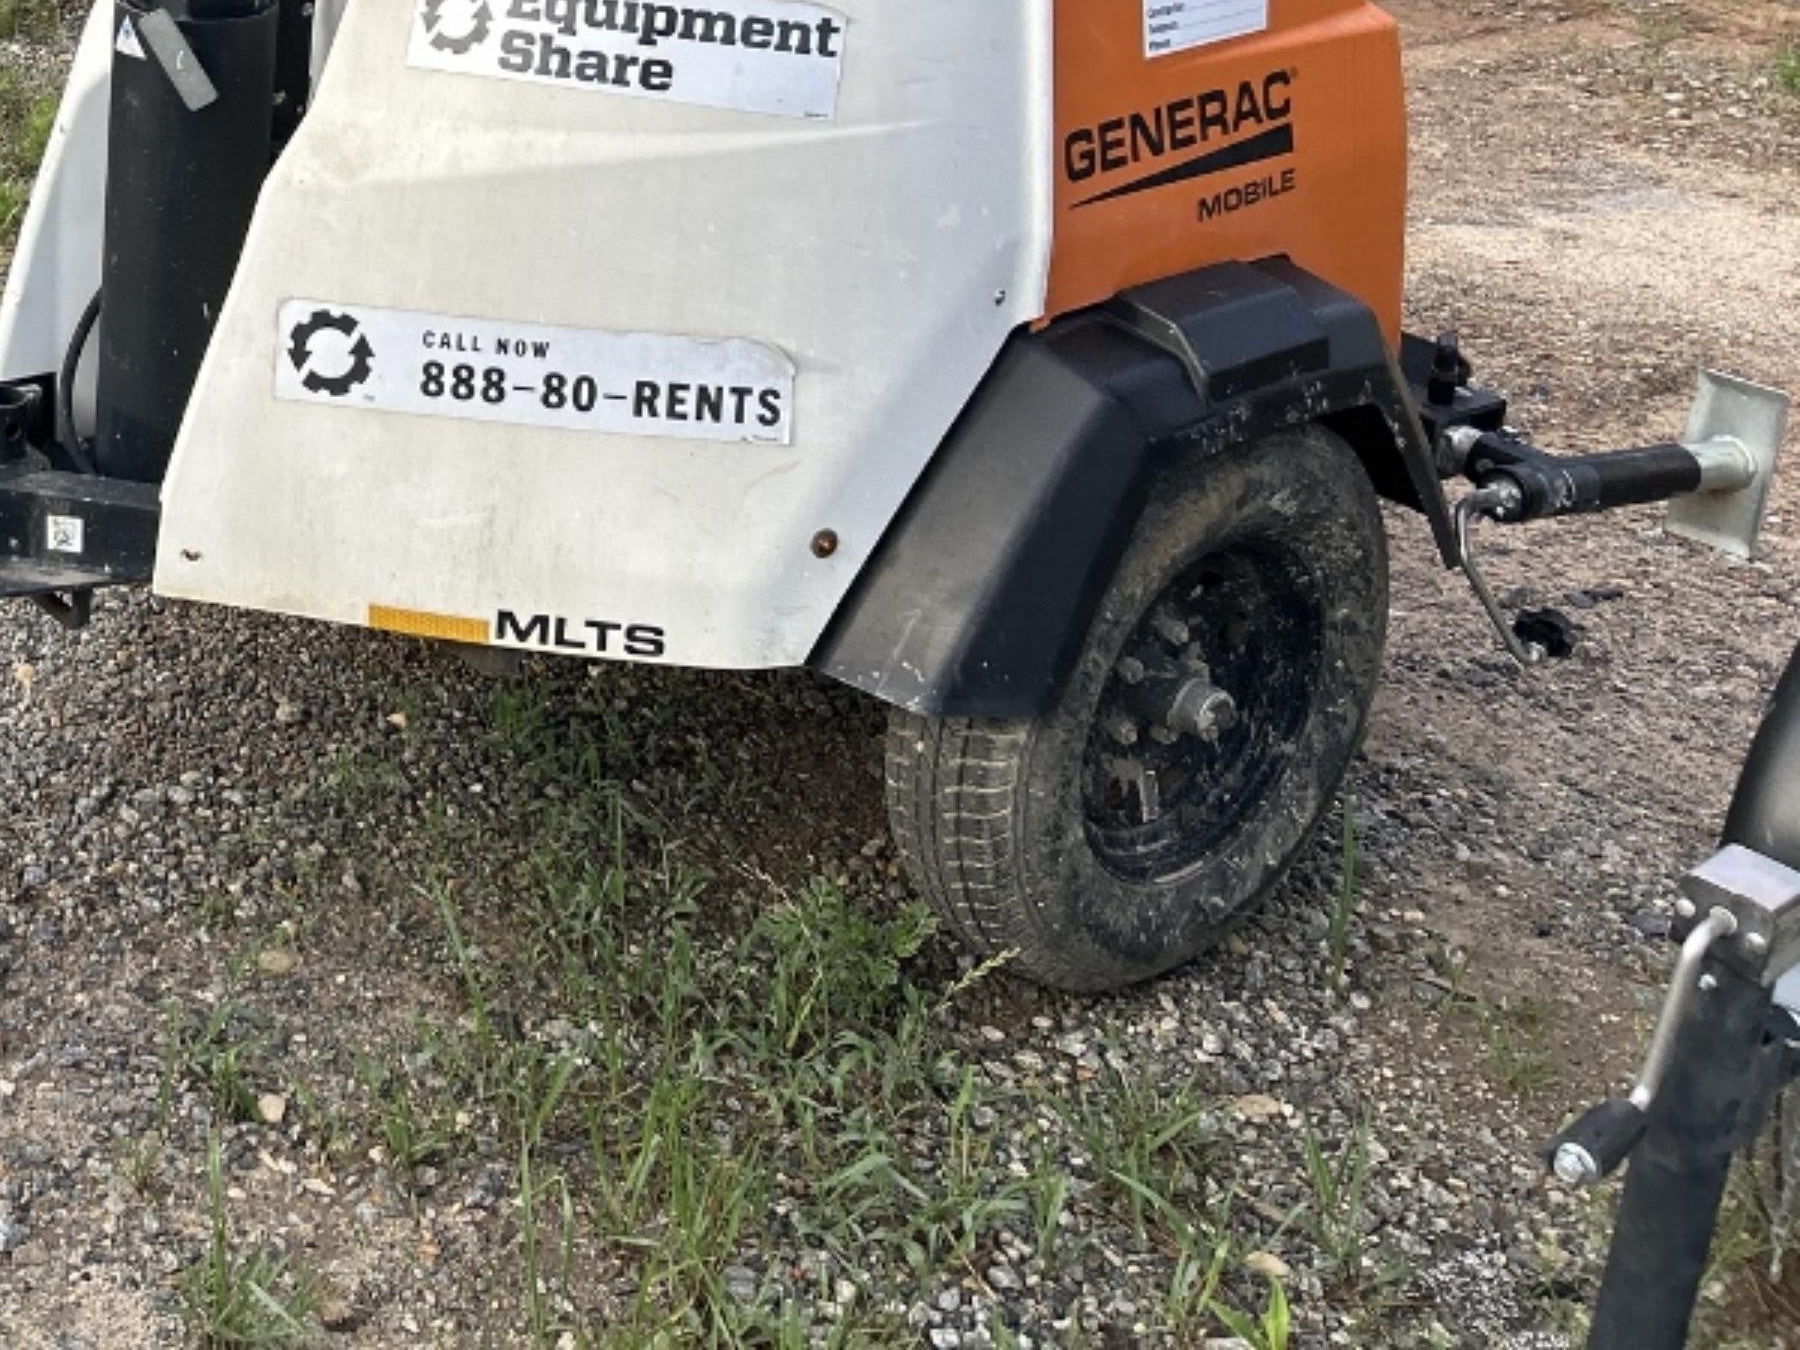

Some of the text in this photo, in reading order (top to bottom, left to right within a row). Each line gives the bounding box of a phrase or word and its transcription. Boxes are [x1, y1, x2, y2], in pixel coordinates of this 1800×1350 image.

[497, 29, 673, 91] Share
[1064, 68, 1293, 183] GENERAC
[1197, 167, 1296, 222] MOBILE
[422, 330, 551, 360] CALL NOW
[419, 360, 782, 427] 888-80-RENTS
[495, 609, 666, 657] MLTS
